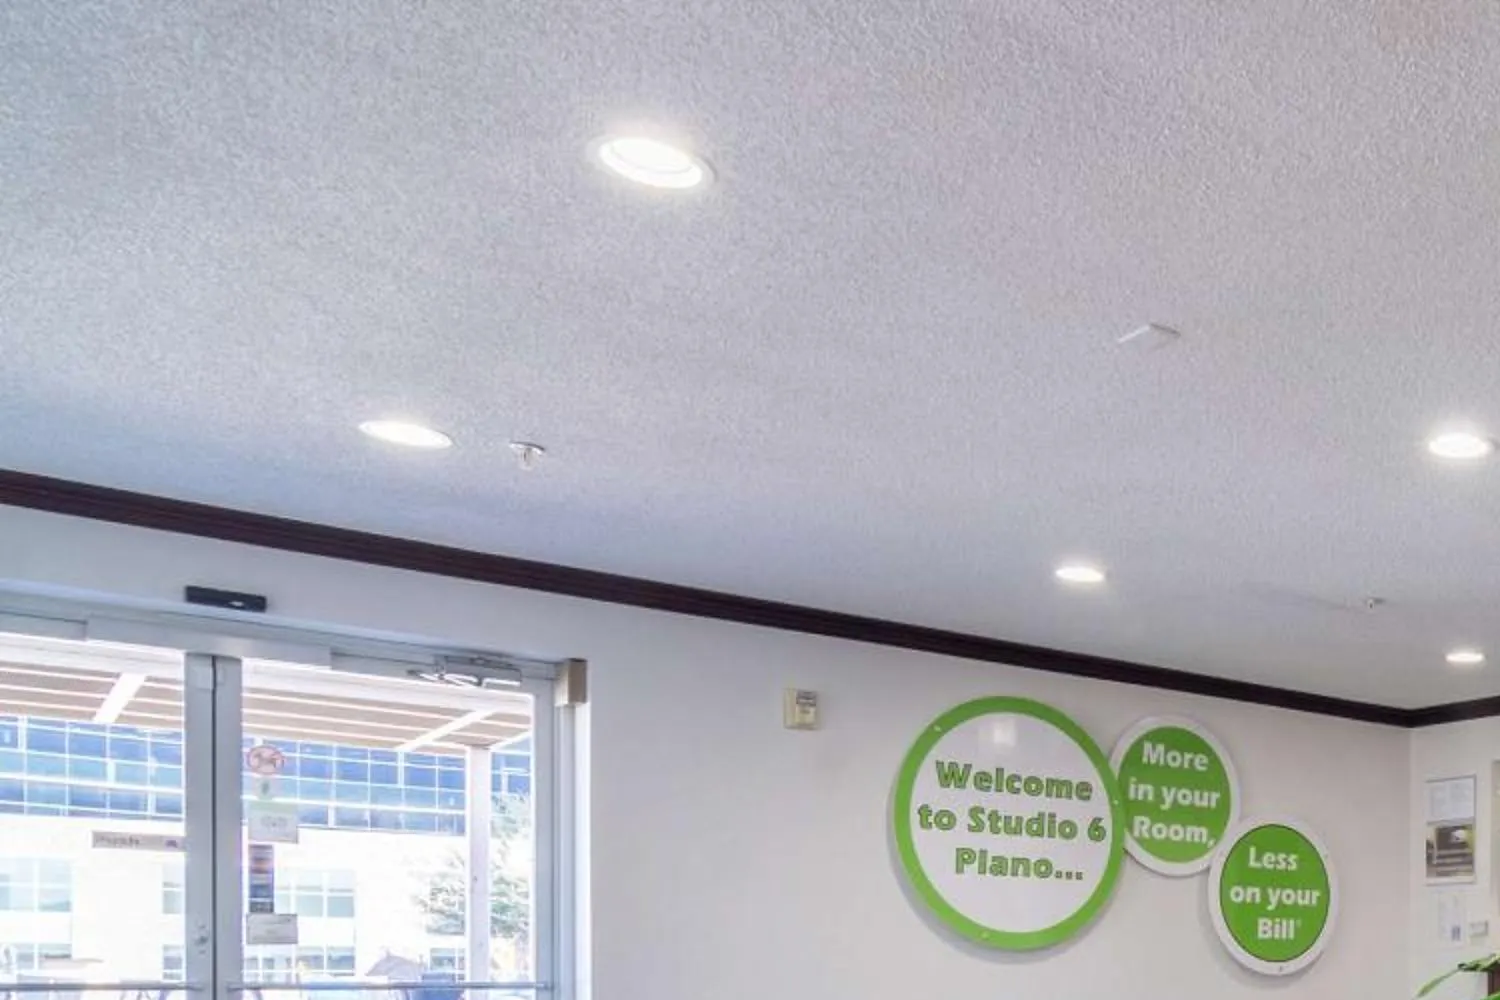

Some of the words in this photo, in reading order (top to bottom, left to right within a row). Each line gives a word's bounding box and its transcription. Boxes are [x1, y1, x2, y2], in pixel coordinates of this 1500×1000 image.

[1142, 741, 1208, 771] More
[936, 760, 1093, 801] Welcome
[1129, 777, 1153, 800] in
[1160, 786, 1220, 811] your
[917, 804, 957, 831] to
[967, 805, 1078, 840] Studio
[1087, 817, 1107, 842] 6
[1133, 816, 1216, 848] Room,
[955, 847, 1083, 880] Plano...
[1248, 847, 1298, 871] Less
[1230, 885, 1260, 904] on
[1267, 888, 1320, 910] your
